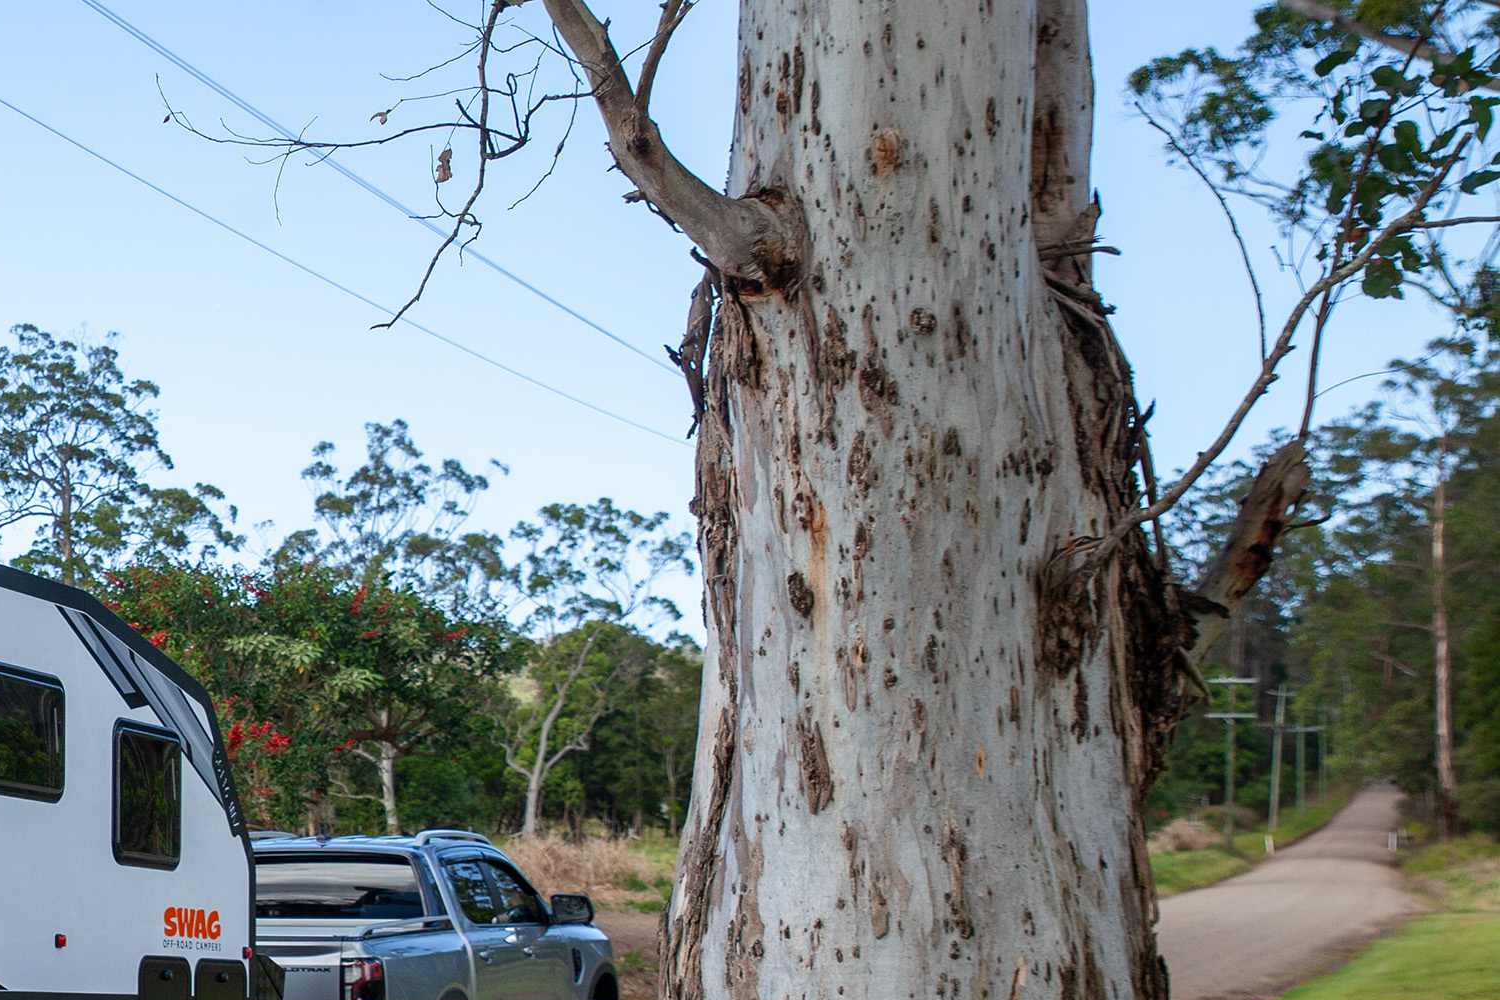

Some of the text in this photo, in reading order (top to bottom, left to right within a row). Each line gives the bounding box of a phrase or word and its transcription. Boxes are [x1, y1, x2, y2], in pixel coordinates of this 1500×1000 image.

[163, 906, 221, 940] SWAG
[163, 939, 222, 952] OFF-ROAD CAMPERS
